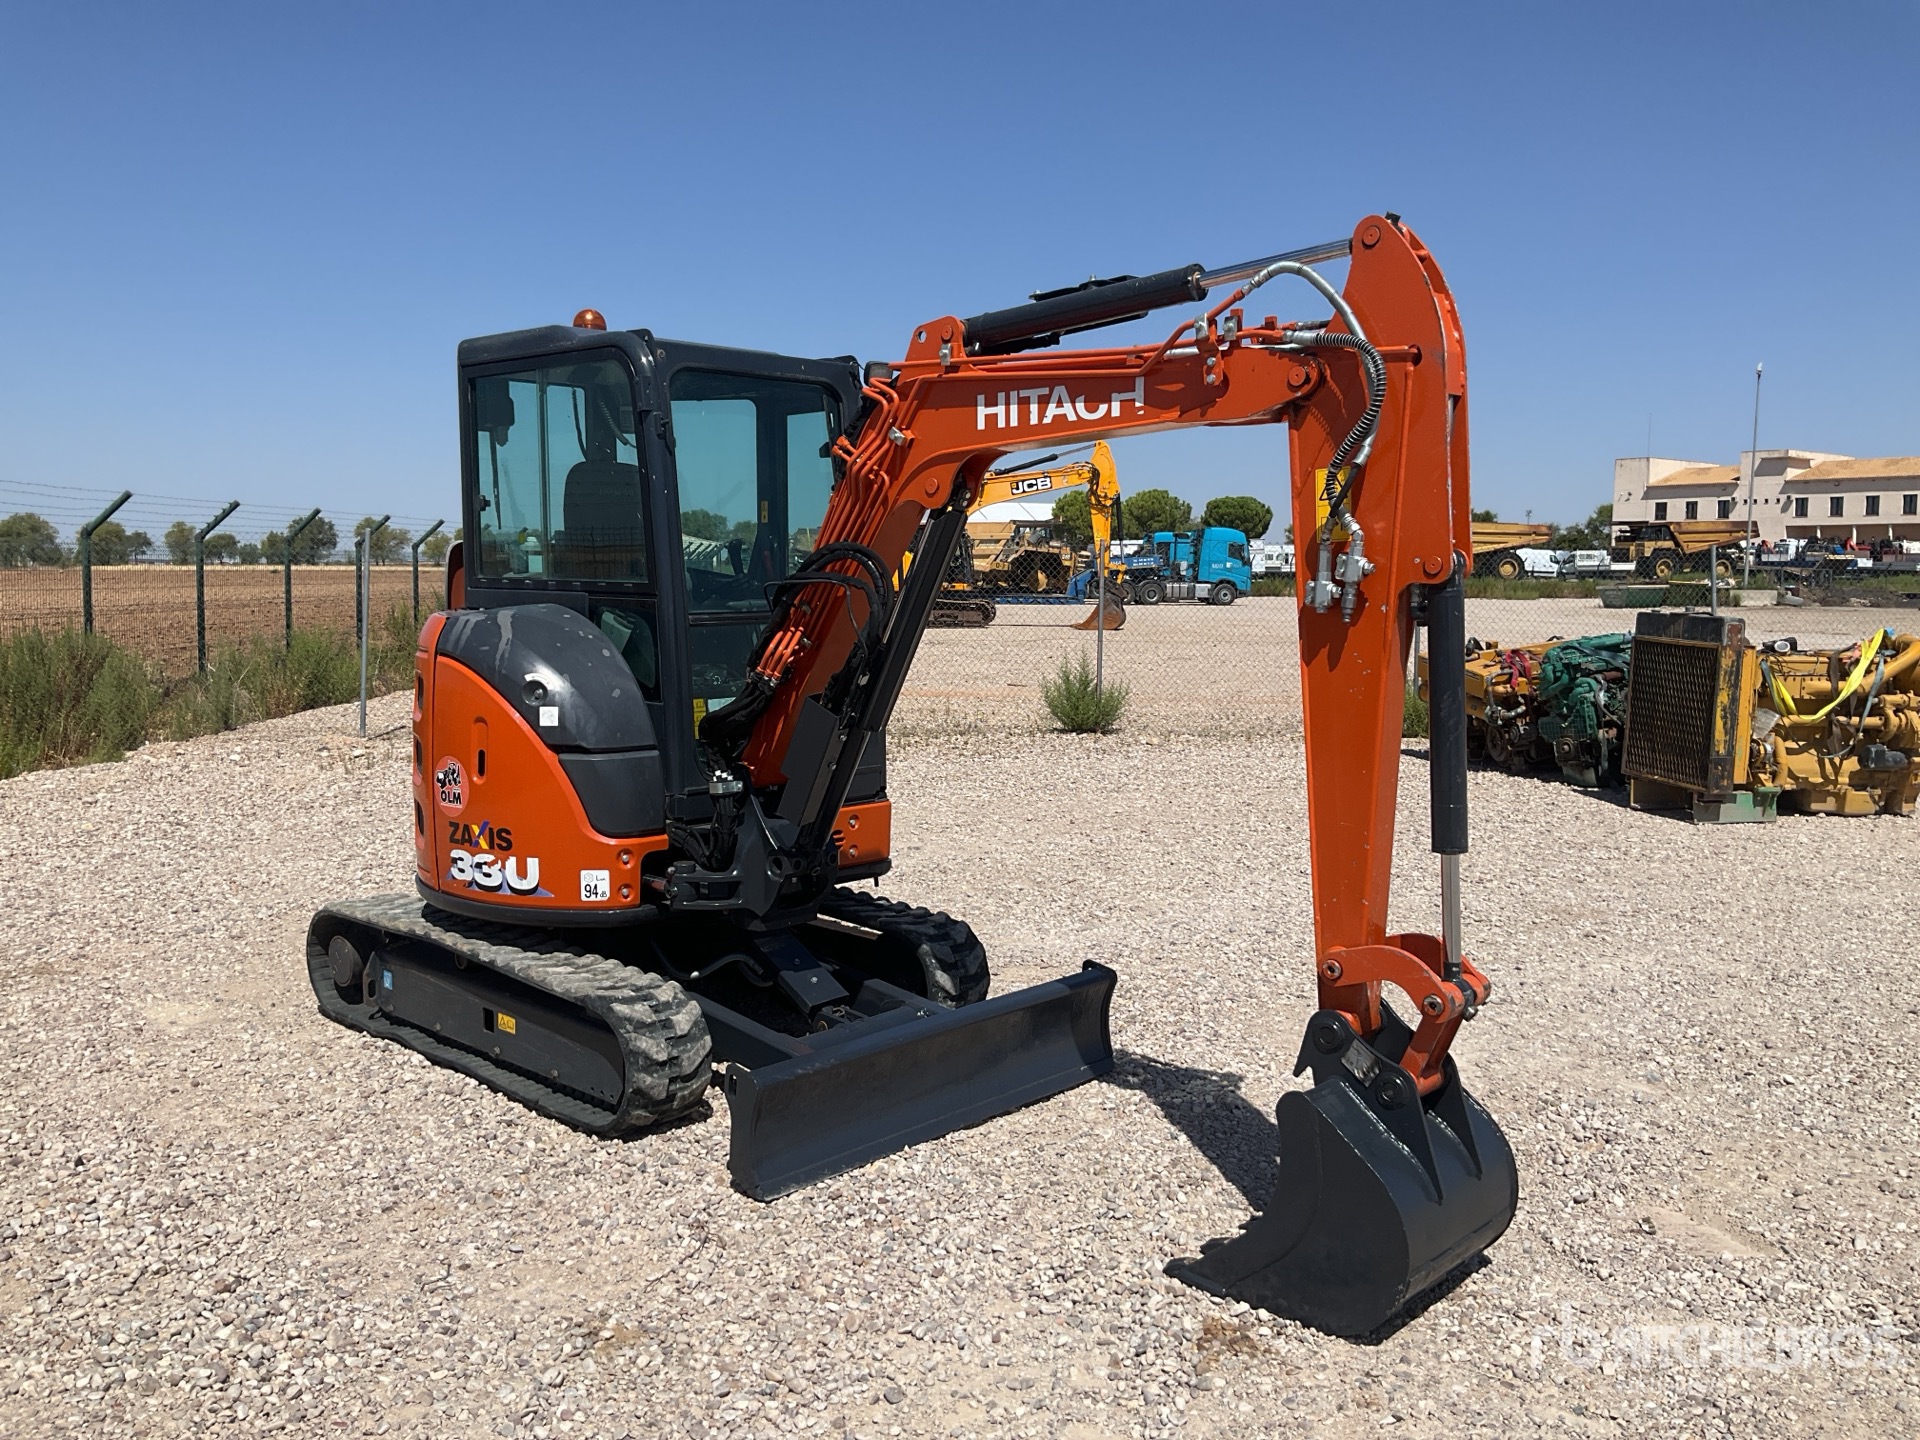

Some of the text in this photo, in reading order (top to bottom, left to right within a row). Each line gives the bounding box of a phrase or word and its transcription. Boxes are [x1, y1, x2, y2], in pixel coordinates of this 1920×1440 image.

[1011, 477, 1052, 495] JCB
[440, 789, 462, 805] OLM
[448, 820, 513, 851] ZAXIS
[450, 849, 540, 895] 33U
[584, 883, 599, 899] 94
